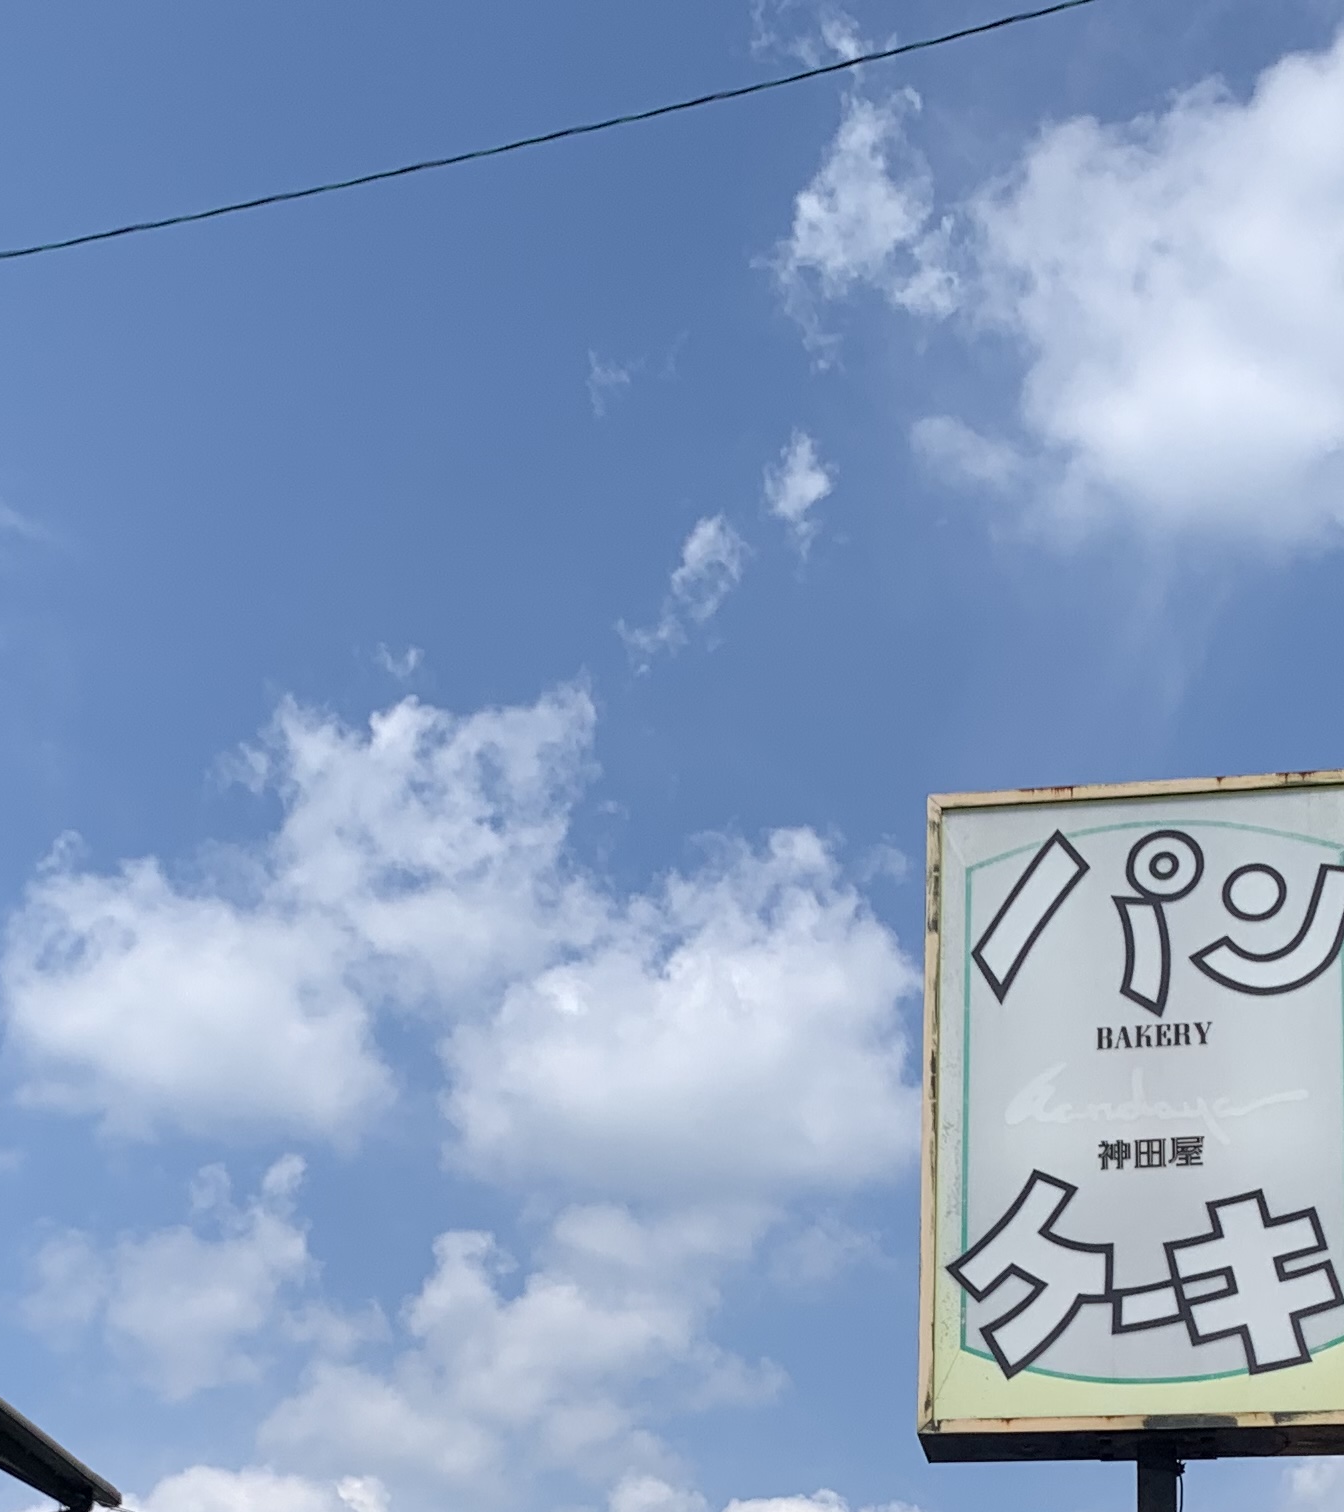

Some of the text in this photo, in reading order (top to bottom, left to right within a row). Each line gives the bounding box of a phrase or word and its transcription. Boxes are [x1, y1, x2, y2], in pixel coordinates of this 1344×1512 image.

[1096, 1021, 1213, 1051] BAKERY
[1097, 1135, 1206, 1171] 神田屋
